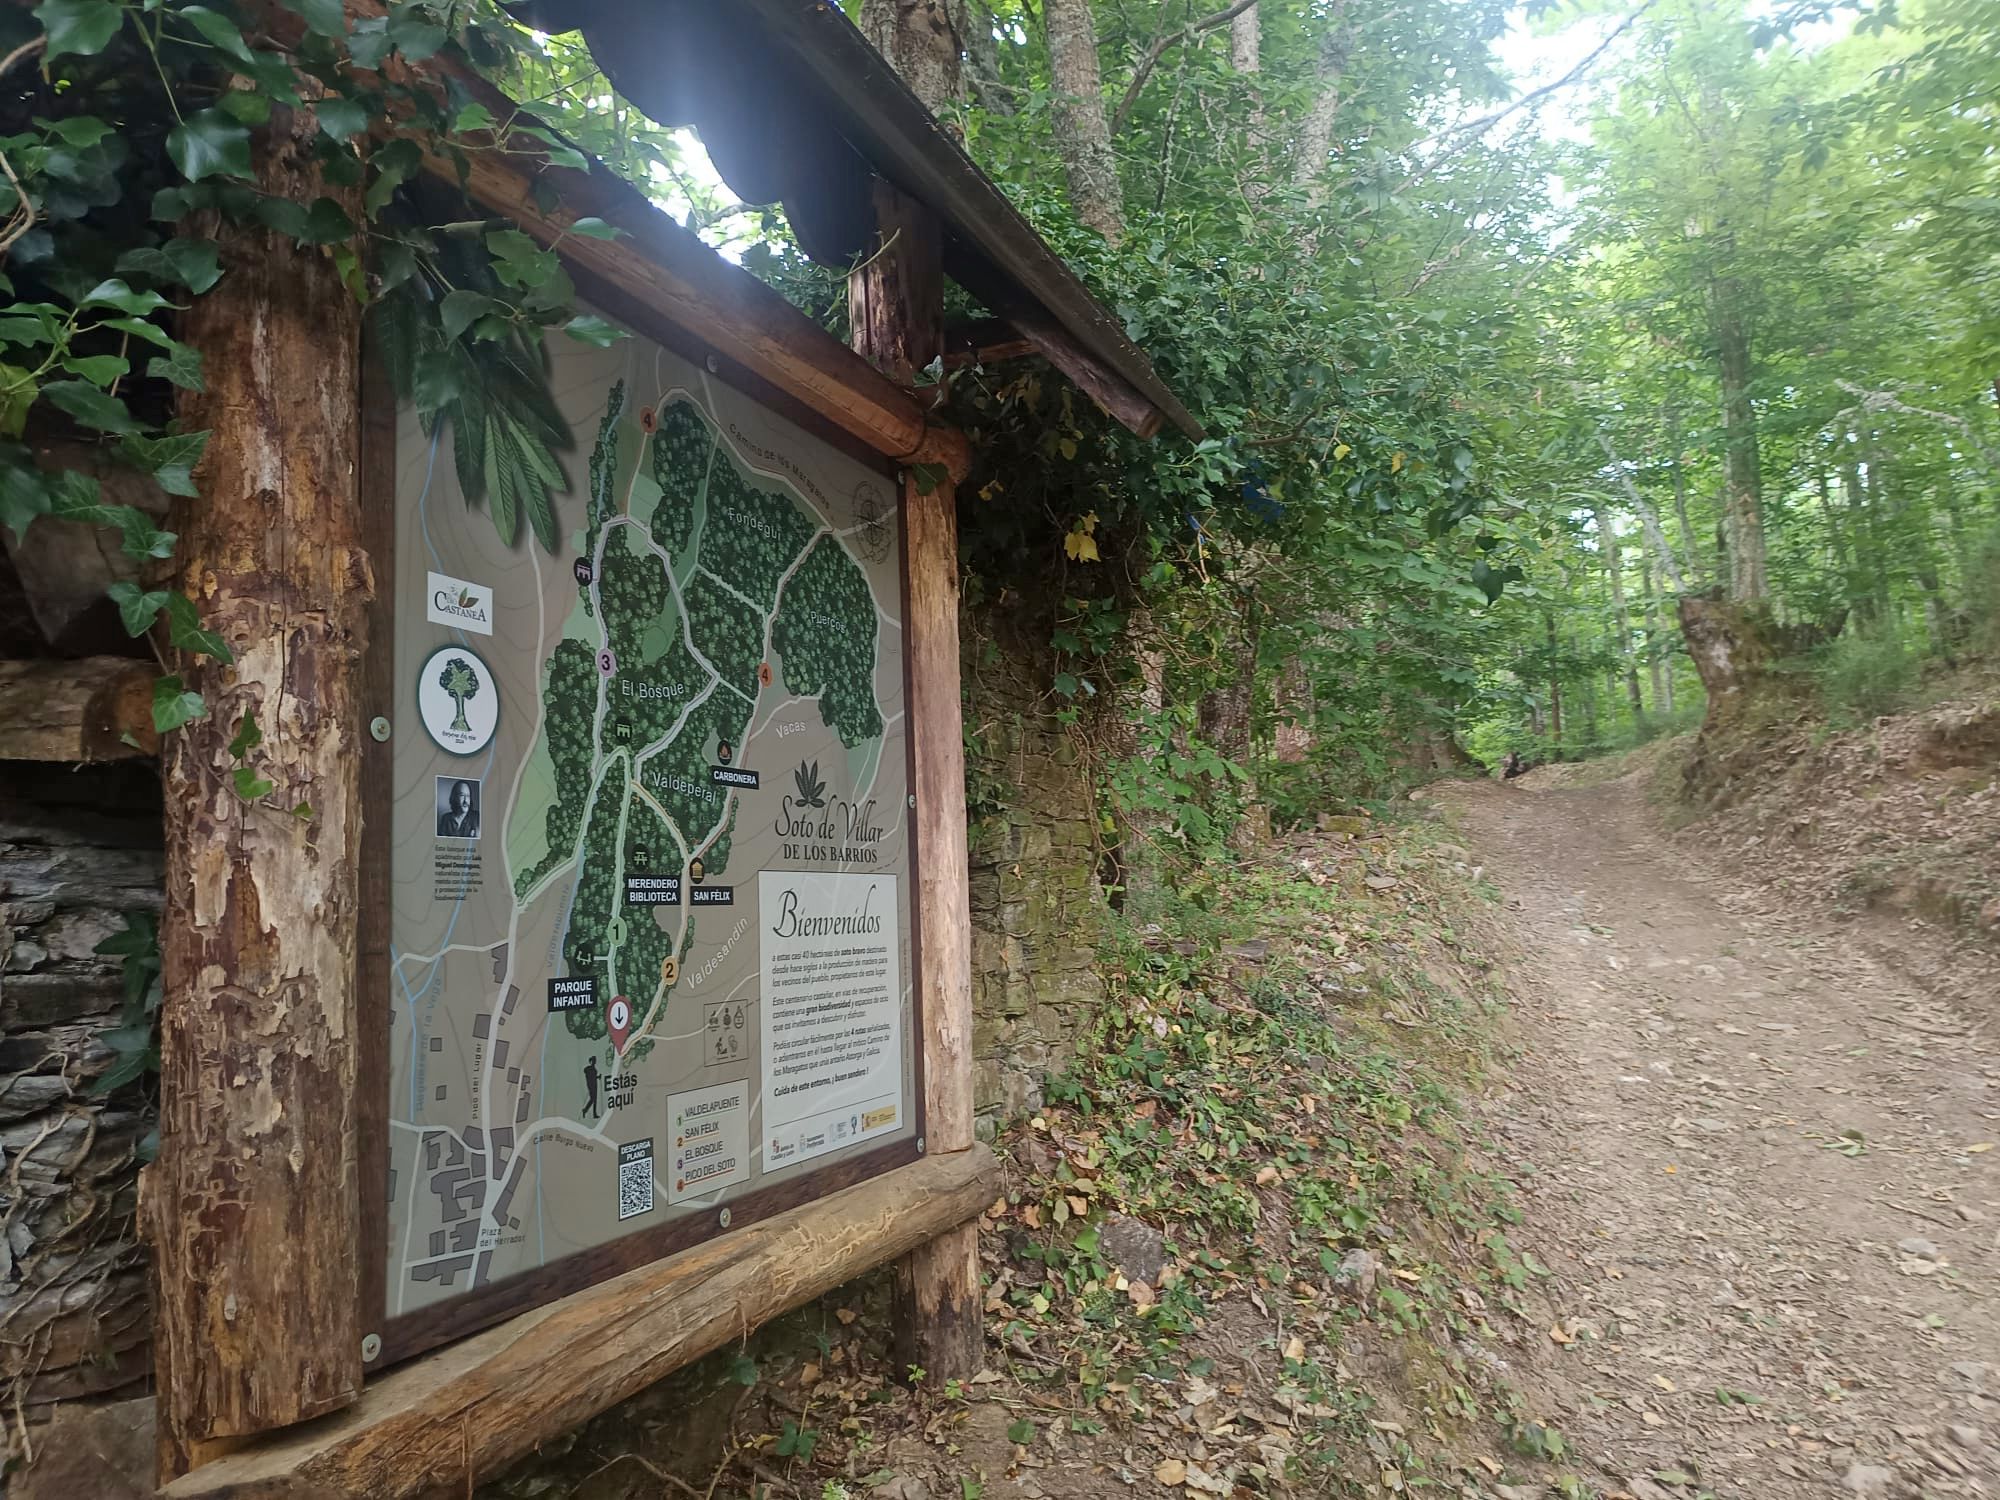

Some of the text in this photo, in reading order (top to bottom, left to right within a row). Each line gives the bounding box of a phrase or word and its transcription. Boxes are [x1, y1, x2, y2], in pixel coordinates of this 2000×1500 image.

[643, 413, 652, 428] 4
[728, 507, 781, 540] Fondegui
[810, 611, 846, 634] Puercos
[602, 654, 610, 671] 3
[762, 668, 769, 682] 4
[622, 679, 685, 700] El Bosque
[776, 720, 807, 739] Vacas
[713, 770, 757, 785] CARBONERA
[652, 772, 717, 805] Valdeperal
[775, 794, 884, 843] Soto de Villar
[783, 843, 878, 863] DE LOS BARRIOS
[628, 878, 679, 889] MERENDERO
[629, 891, 677, 902] BIBLIOTECA
[693, 889, 731, 901] SAN FÉLIX
[773, 884, 880, 938] Bienvenidos
[612, 923, 619, 940] 1
[665, 962, 674, 979] 2
[555, 980, 592, 994] PARQUE
[554, 994, 594, 1008] INFANTIL
[604, 1071, 638, 1091] Estás
[607, 1088, 634, 1111] aquí
[685, 1096, 740, 1117] VALDELAPUENTE
[685, 1126, 700, 1139] SAN
[621, 1140, 651, 1154] DESCARGA
[685, 1149, 694, 1160] EL
[695, 1141, 723, 1158] BOSQUE
[626, 1151, 645, 1161] PLANO
[685, 1168, 702, 1181] PICO
[703, 1164, 717, 1176] DEL
[718, 1158, 736, 1171] SOTO
